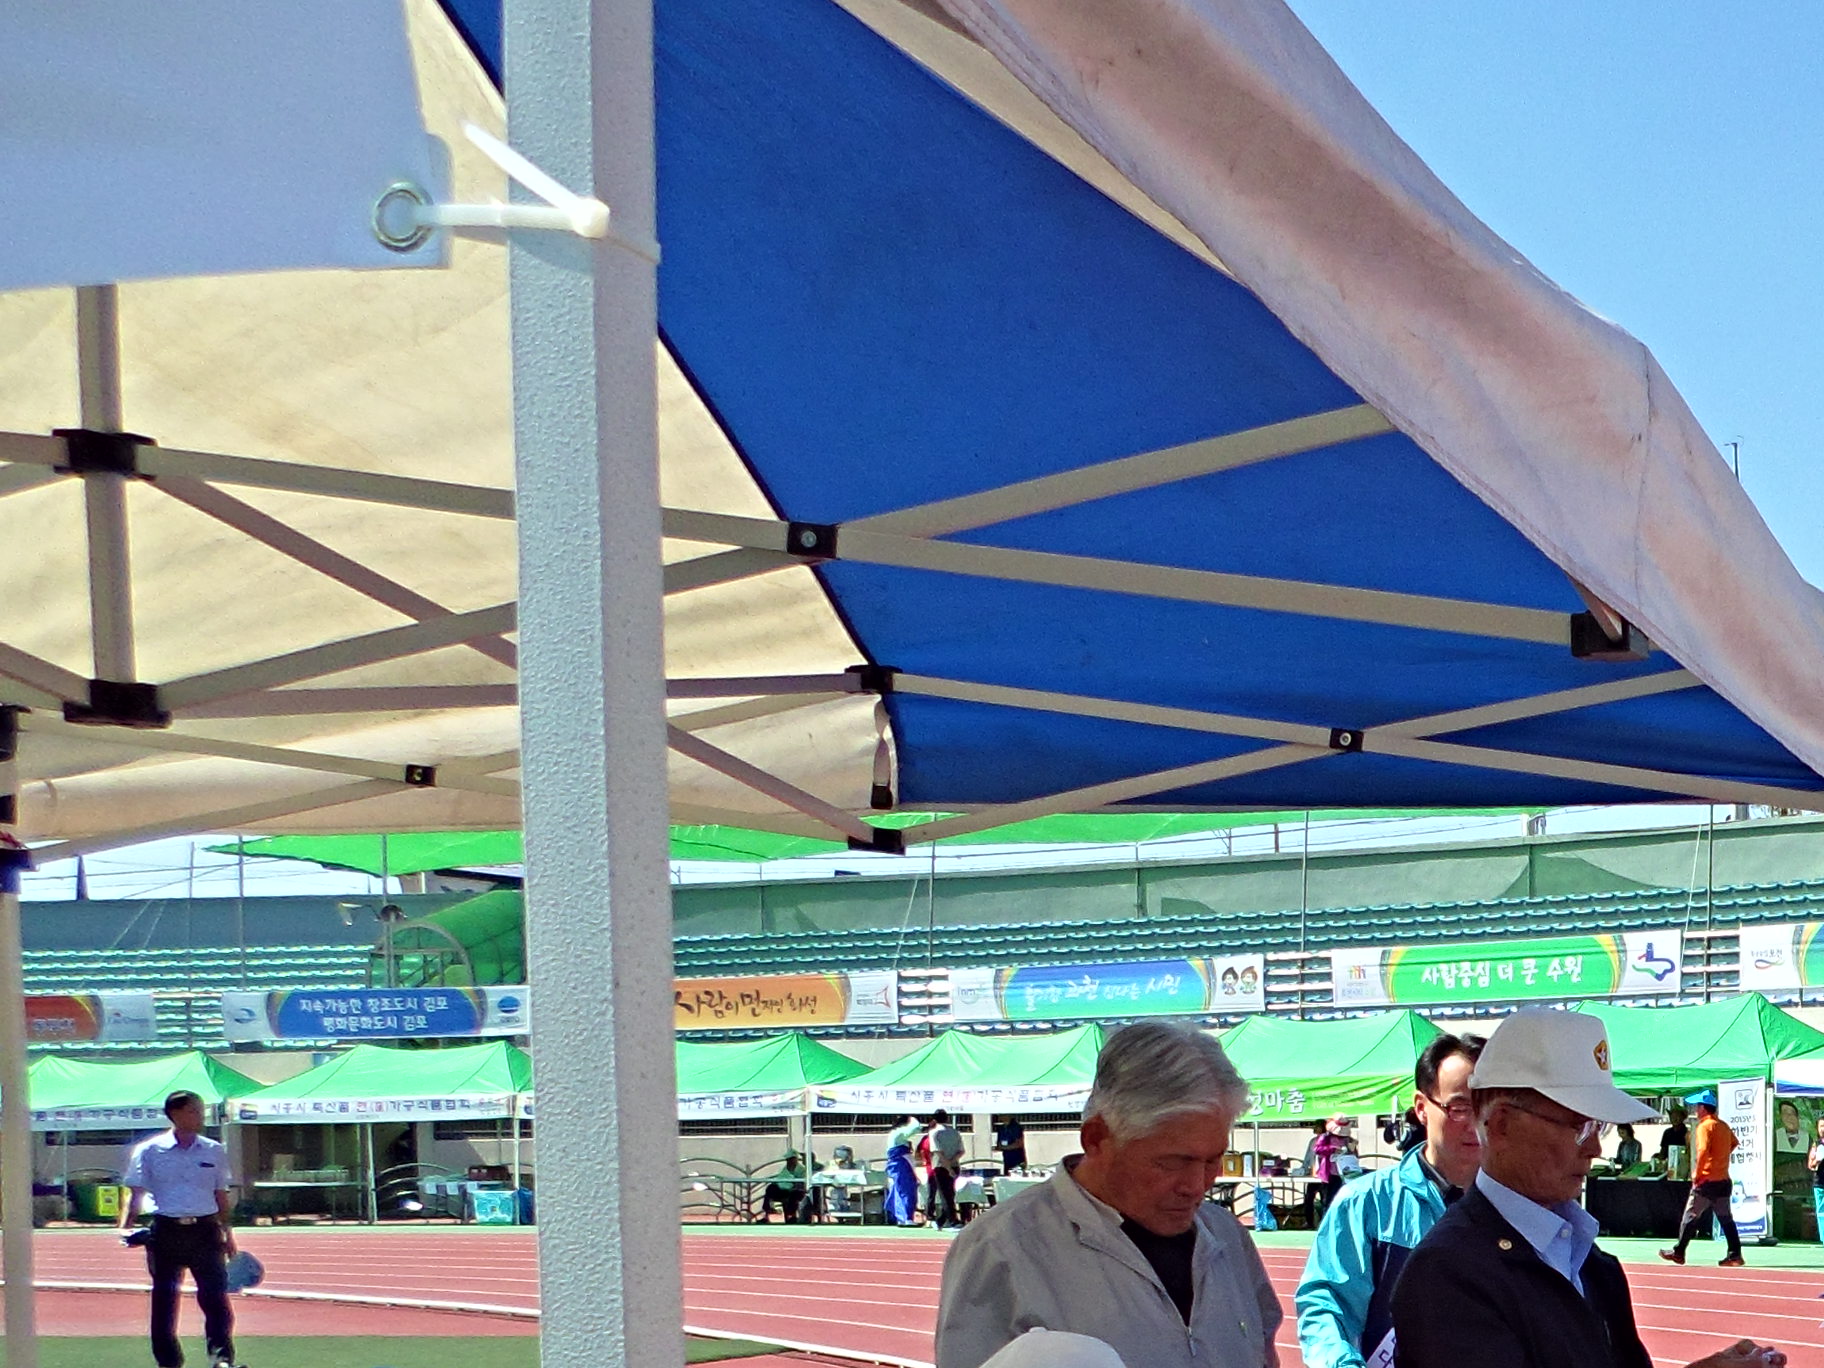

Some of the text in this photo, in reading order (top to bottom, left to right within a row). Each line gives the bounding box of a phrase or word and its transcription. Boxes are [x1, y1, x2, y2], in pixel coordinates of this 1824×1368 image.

[1498, 961, 1515, 982] 더
[1520, 957, 1540, 985] 큰
[1546, 955, 1583, 983] 수원
[1145, 974, 1181, 995] 시민
[300, 996, 449, 1013] 지속가능한 창조도시 김포
[674, 989, 739, 1019] 사람이
[788, 992, 818, 1015] 화성
[323, 1015, 429, 1032] 평화문화도시 김포
